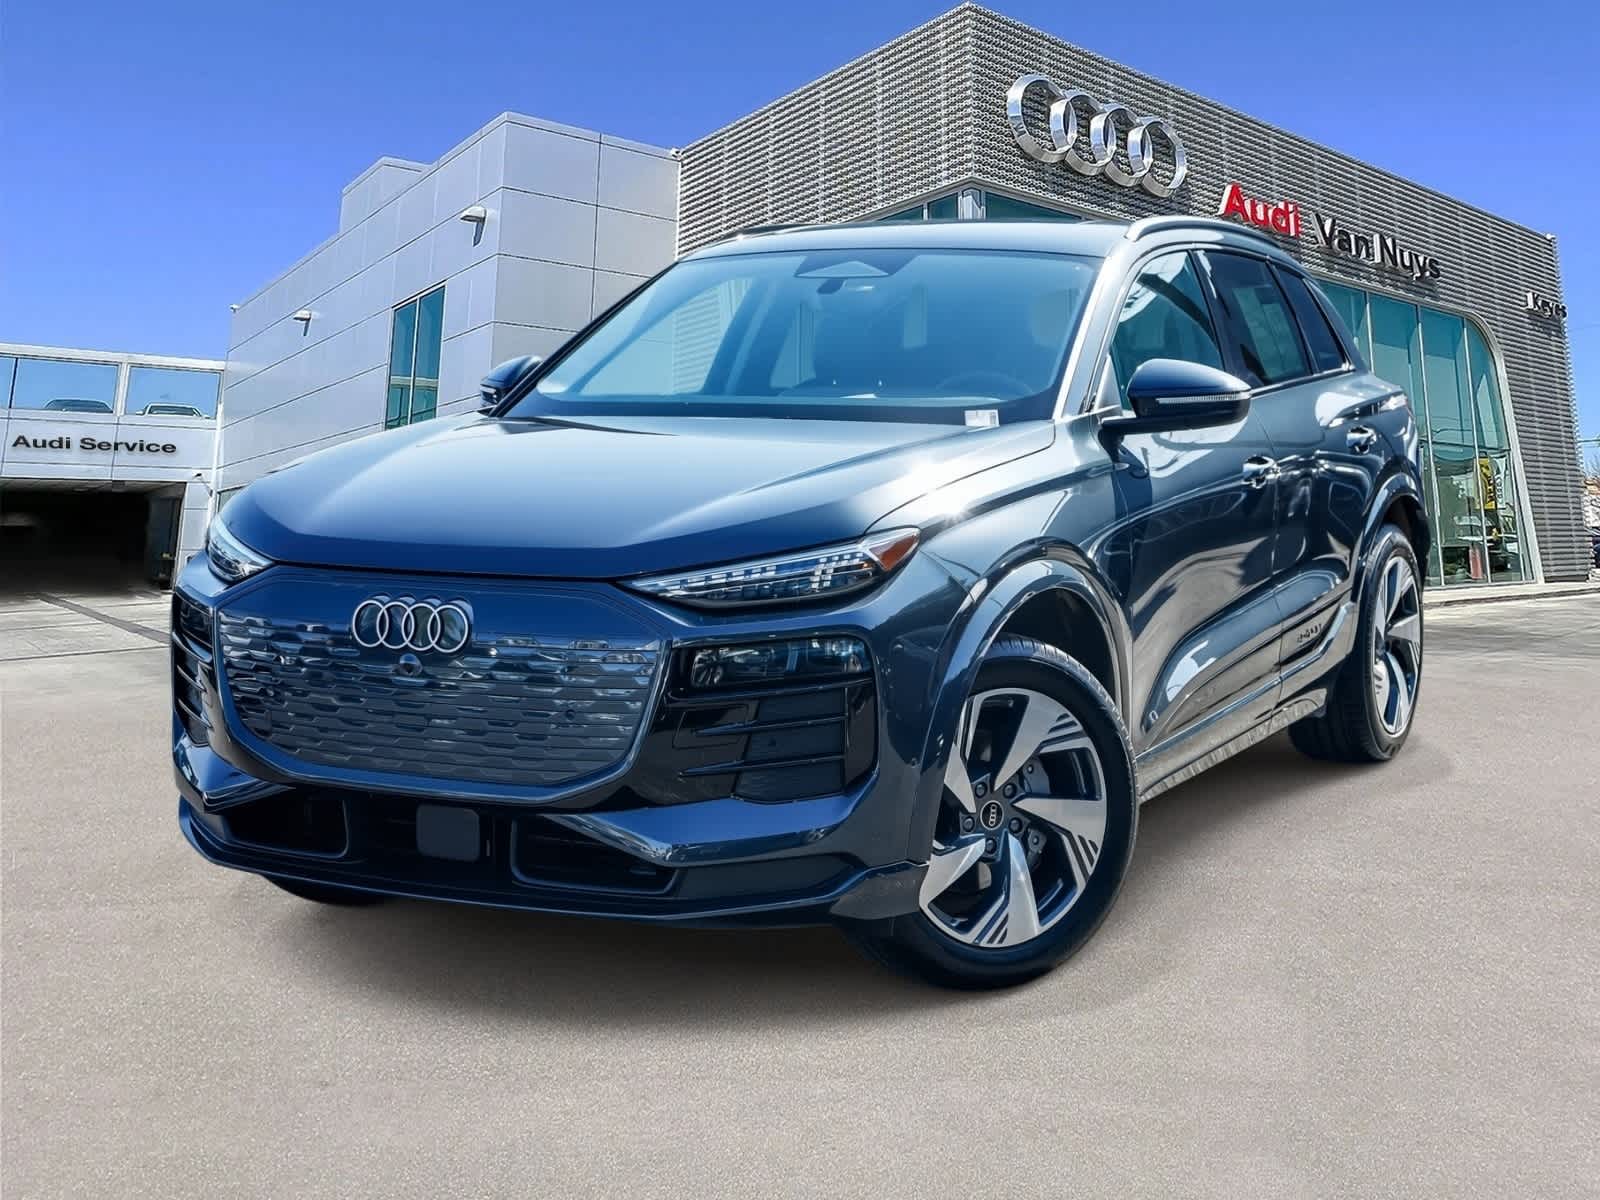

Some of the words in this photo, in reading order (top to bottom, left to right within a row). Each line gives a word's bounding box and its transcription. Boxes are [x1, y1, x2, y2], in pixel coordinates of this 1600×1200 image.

[1217, 183, 1301, 238] Audi
[1310, 212, 1372, 259] Van
[1373, 233, 1441, 281] Nuys
[12, 435, 71, 449] Audi
[79, 437, 177, 454] Service
